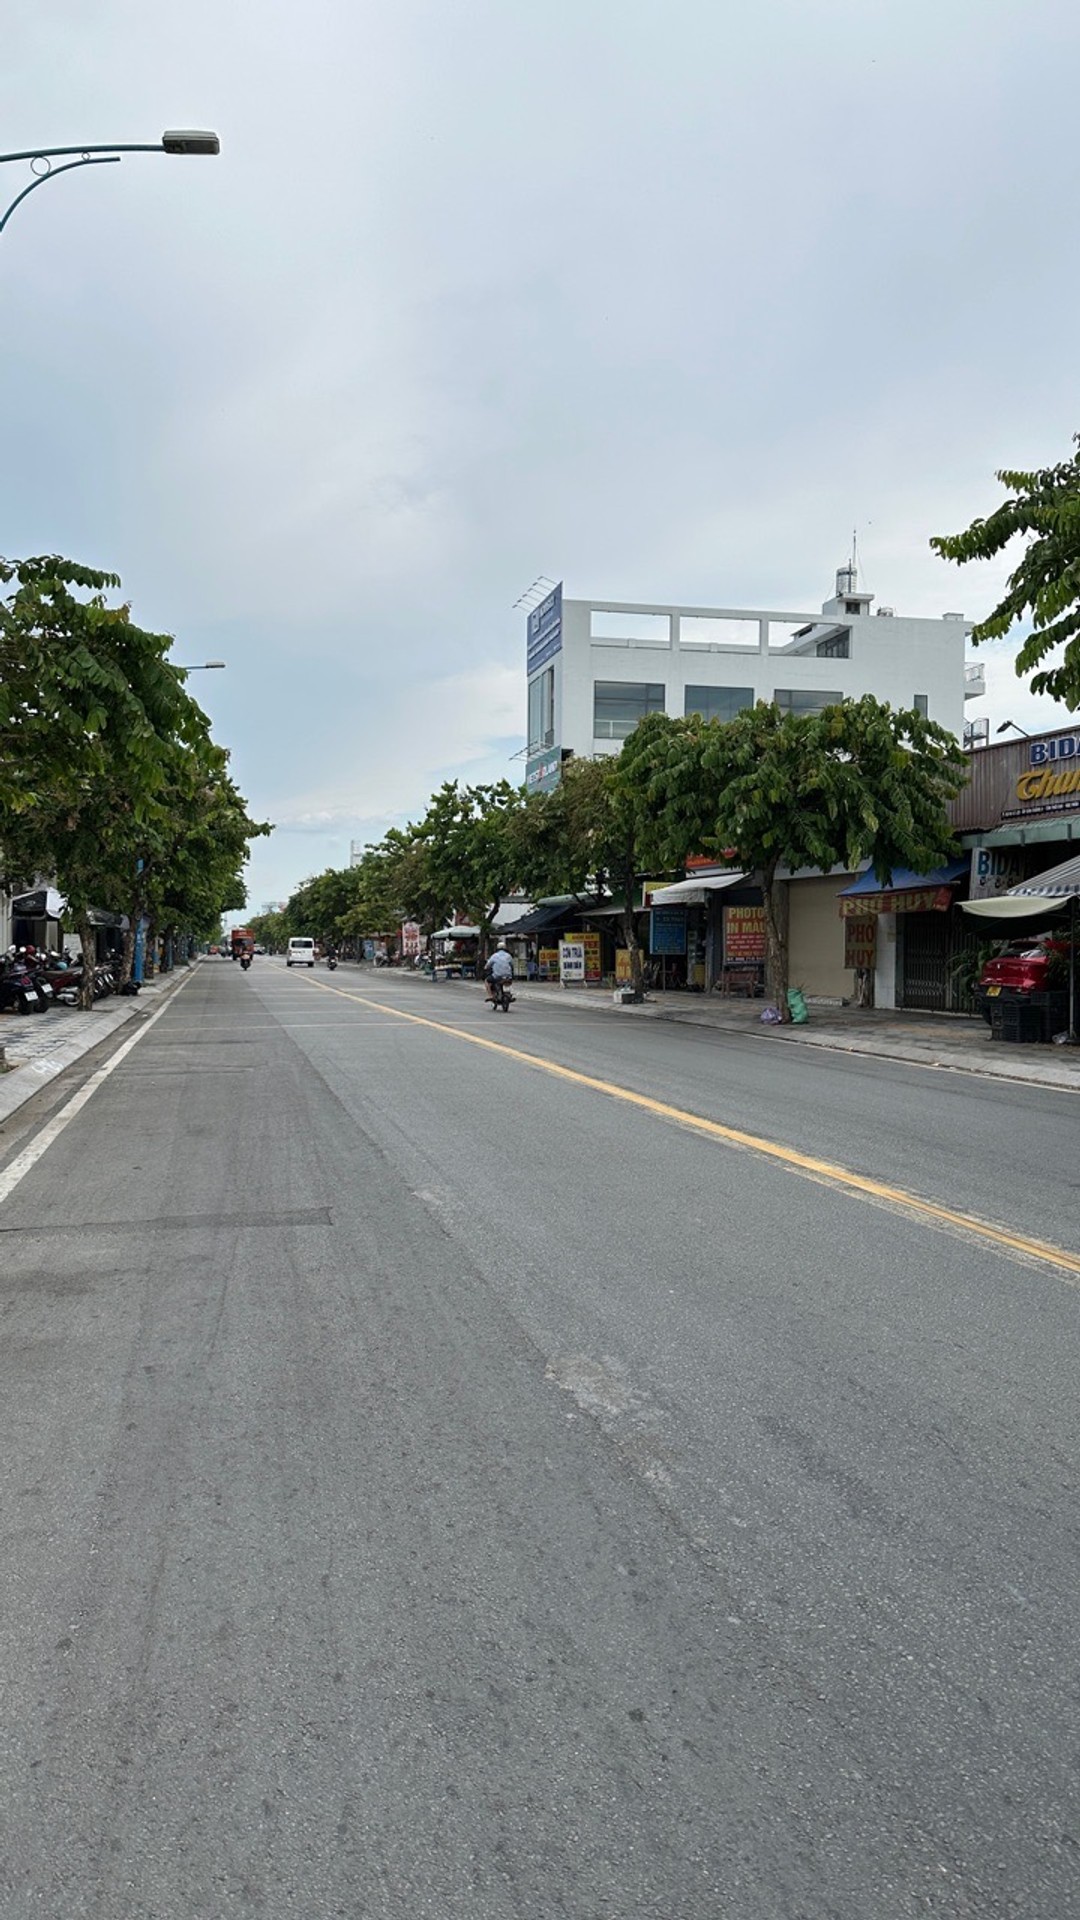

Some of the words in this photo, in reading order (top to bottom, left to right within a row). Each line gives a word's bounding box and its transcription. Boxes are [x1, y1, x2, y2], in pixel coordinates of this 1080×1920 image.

[1030, 736, 1080, 765] BID
[890, 891, 937, 914] HUY
[727, 922, 739, 934] IN
[847, 950, 874, 967] HUY
